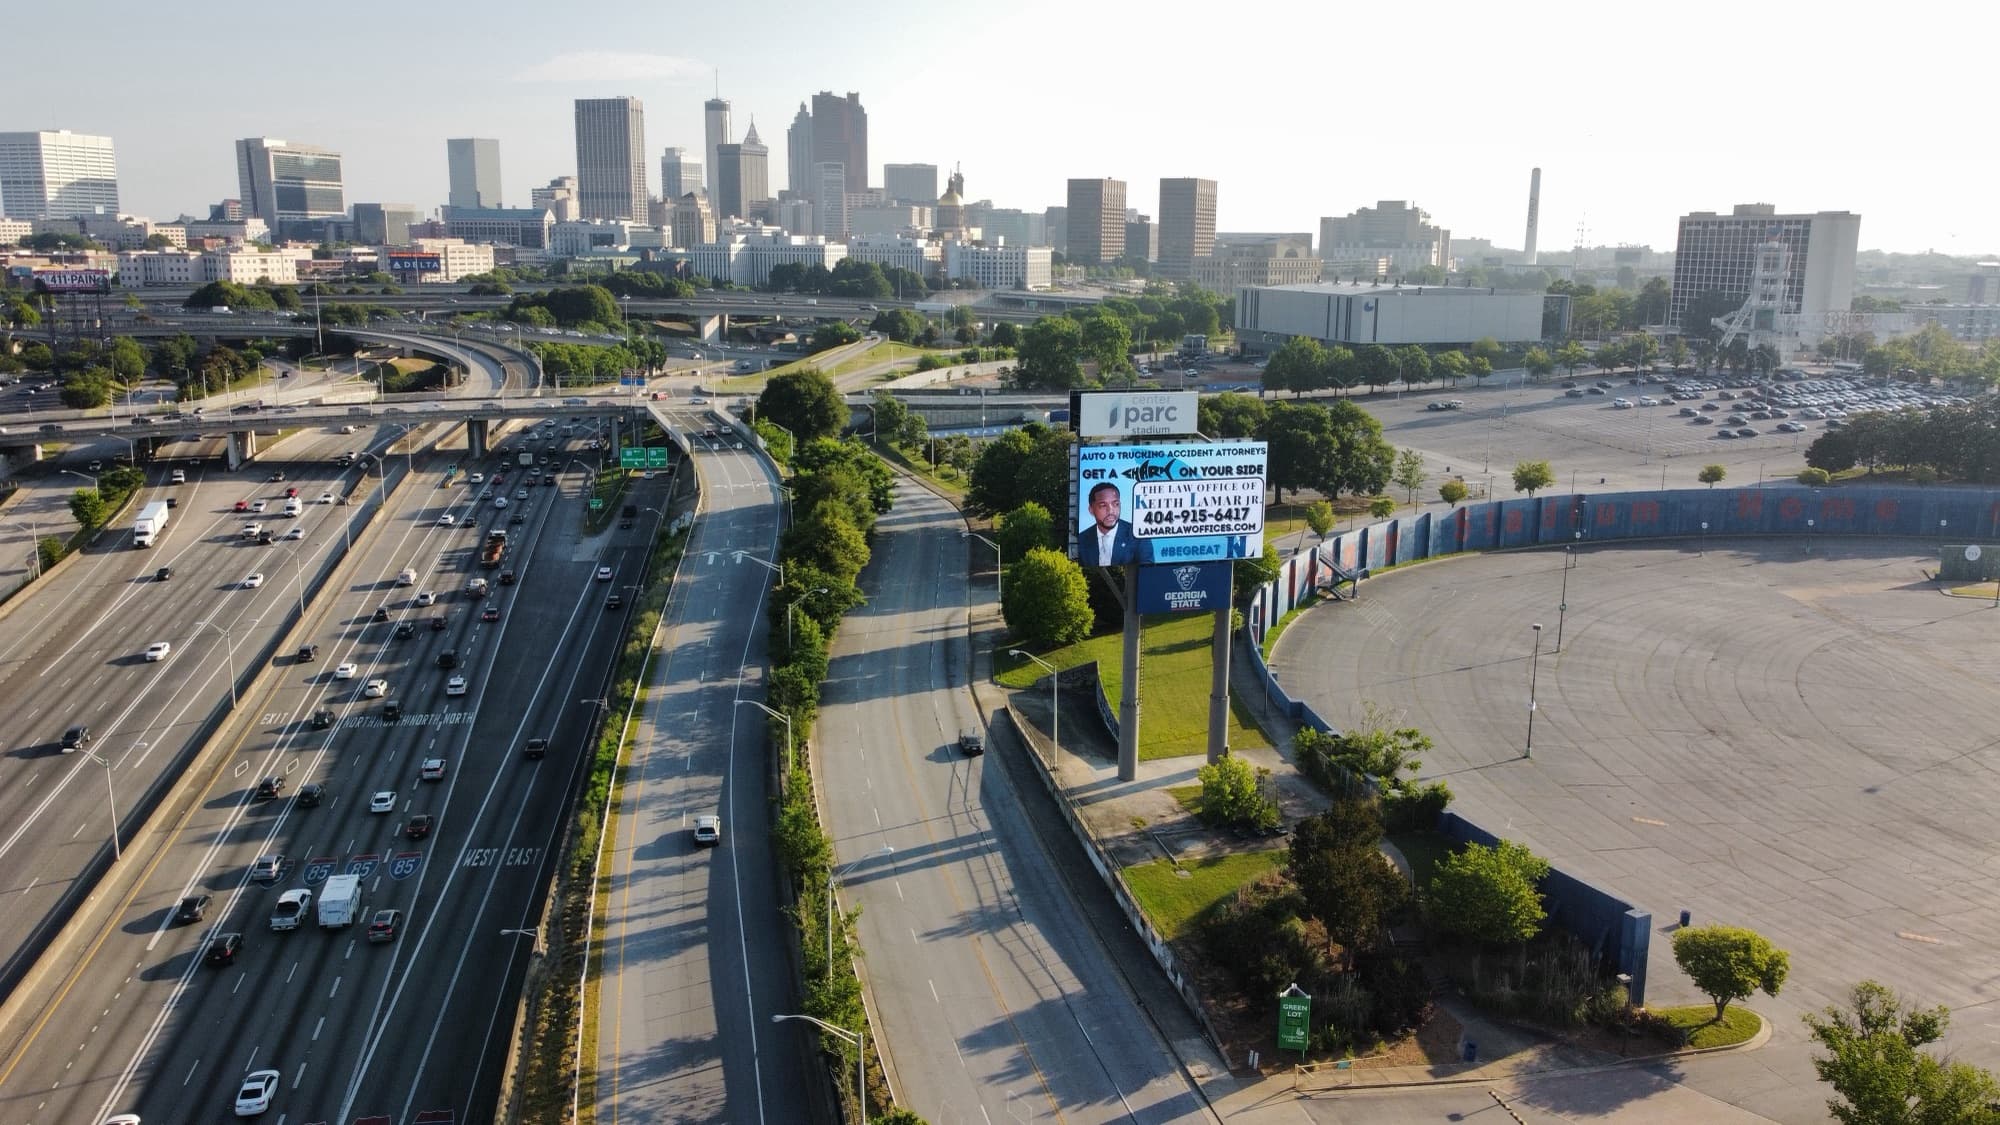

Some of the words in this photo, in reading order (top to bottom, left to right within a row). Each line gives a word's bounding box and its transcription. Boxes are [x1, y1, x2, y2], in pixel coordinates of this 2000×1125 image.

[403, 261, 439, 269] DELTA
[1132, 395, 1171, 405] center
[1124, 405, 1177, 429] parc
[1131, 425, 1170, 434] stadium
[1081, 451, 1107, 461] AUTO
[1117, 449, 1165, 460] TRUCKING
[1167, 449, 1214, 458] ACCIDENT
[1215, 447, 1267, 457] ATTORNEYS
[1082, 468, 1106, 480] GET
[1108, 468, 1119, 479] A
[1179, 466, 1198, 478] ON
[1200, 465, 1234, 477] YOUR
[1235, 464, 1264, 476] SIDE
[1141, 484, 1166, 495] THE
[1168, 484, 1192, 493] LAW
[1196, 481, 1238, 492] OFFICE
[1242, 481, 1257, 491] OF
[1135, 494, 1183, 509] KEITH
[1190, 492, 1242, 507] LAMAR
[1245, 494, 1263, 506] JR.
[1143, 507, 1250, 525] 404-915-6417
[1138, 522, 1256, 536] LAMARLAWOFFICES.COM
[1160, 544, 1221, 558] #BEGREAT
[1164, 590, 1207, 601] GEORGIA
[1170, 599, 1201, 608] STATE
[260, 712, 289, 725] EXIT
[442, 711, 476, 724] NORTH
[463, 848, 499, 867] WEST
[506, 847, 541, 866] EAST
[307, 864, 331, 880] 85
[350, 861, 372, 876] 85
[394, 859, 416, 875] 85
[1282, 1003, 1308, 1011] GREEN
